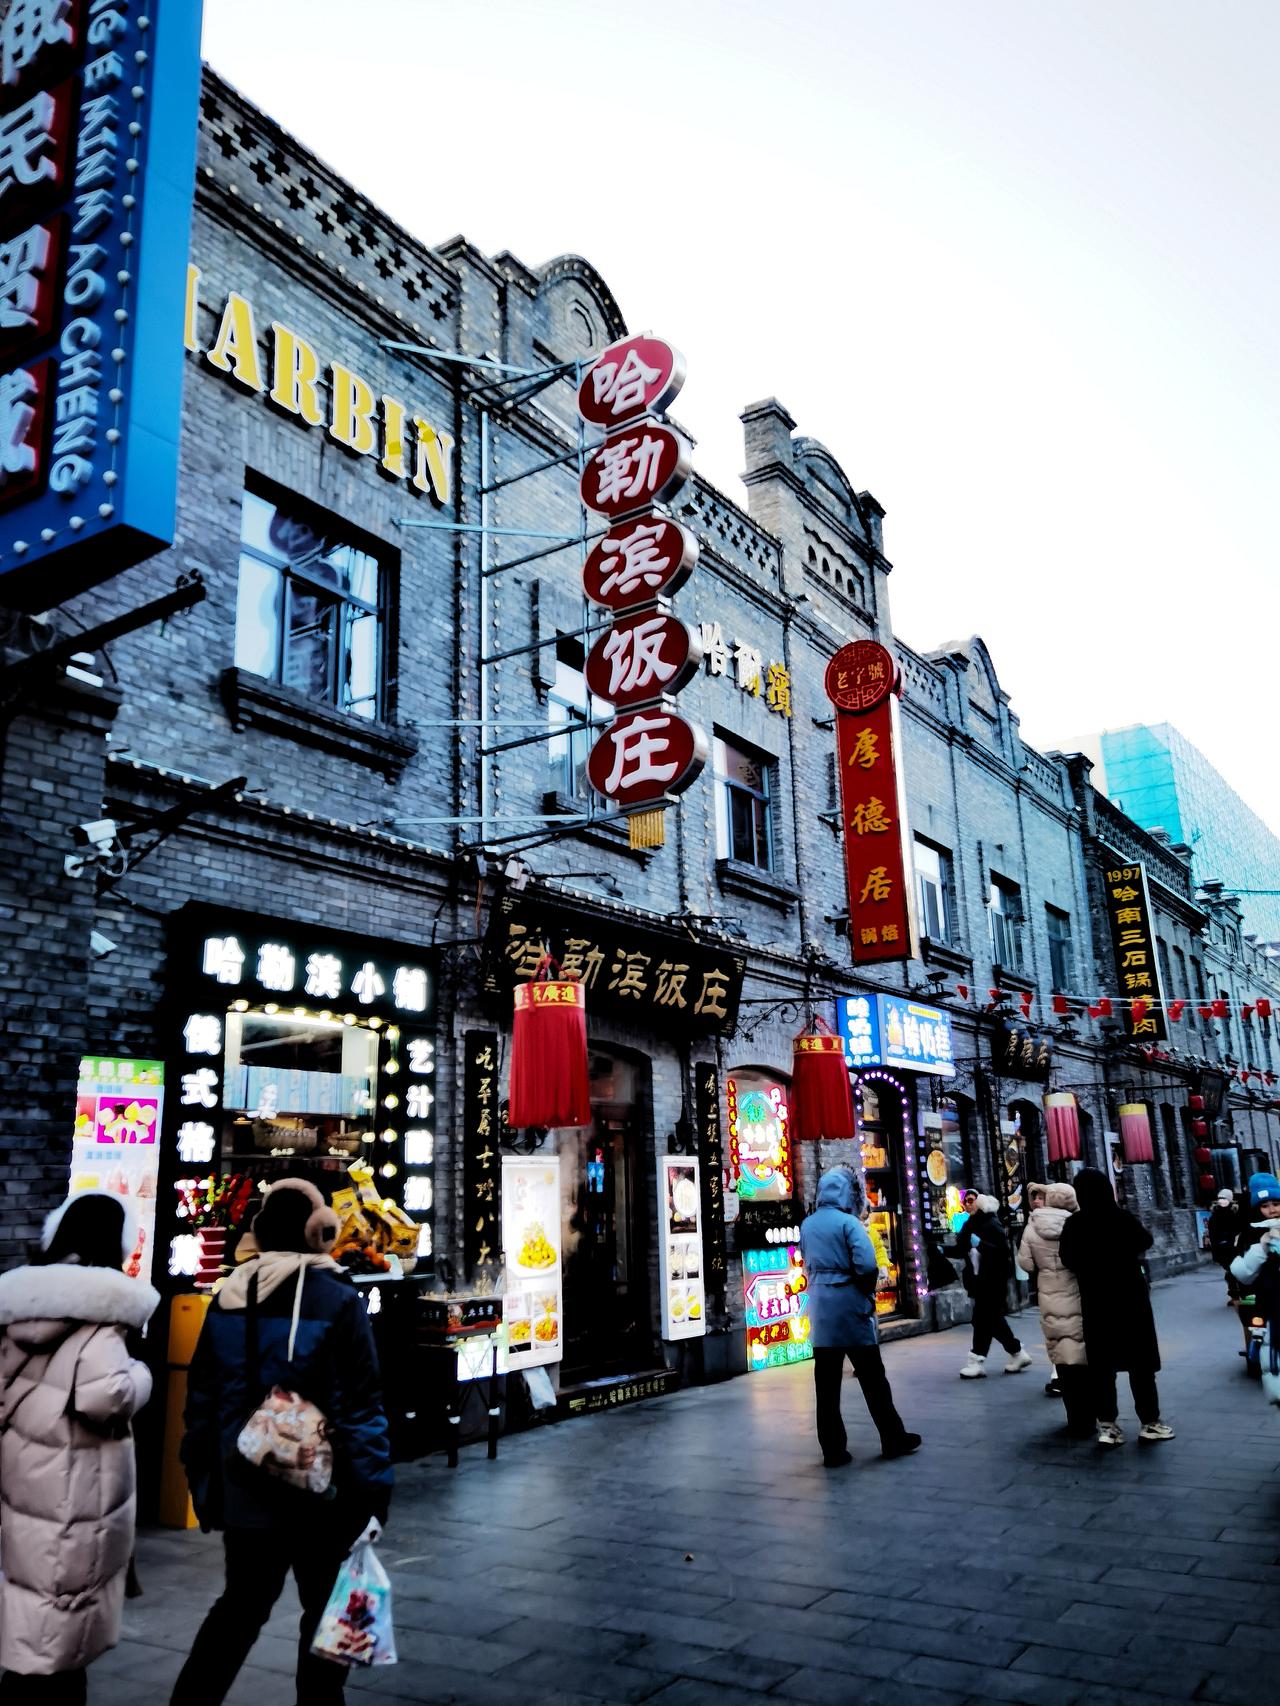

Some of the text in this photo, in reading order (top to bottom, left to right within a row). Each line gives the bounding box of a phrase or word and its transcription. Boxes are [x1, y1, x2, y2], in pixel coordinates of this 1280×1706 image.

[592, 349, 678, 793] 哈勒滨饭庄
[848, 727, 892, 904] 厚德居
[1106, 868, 1140, 883] 1997
[505, 924, 729, 1019] 哈勒滨饭庄
